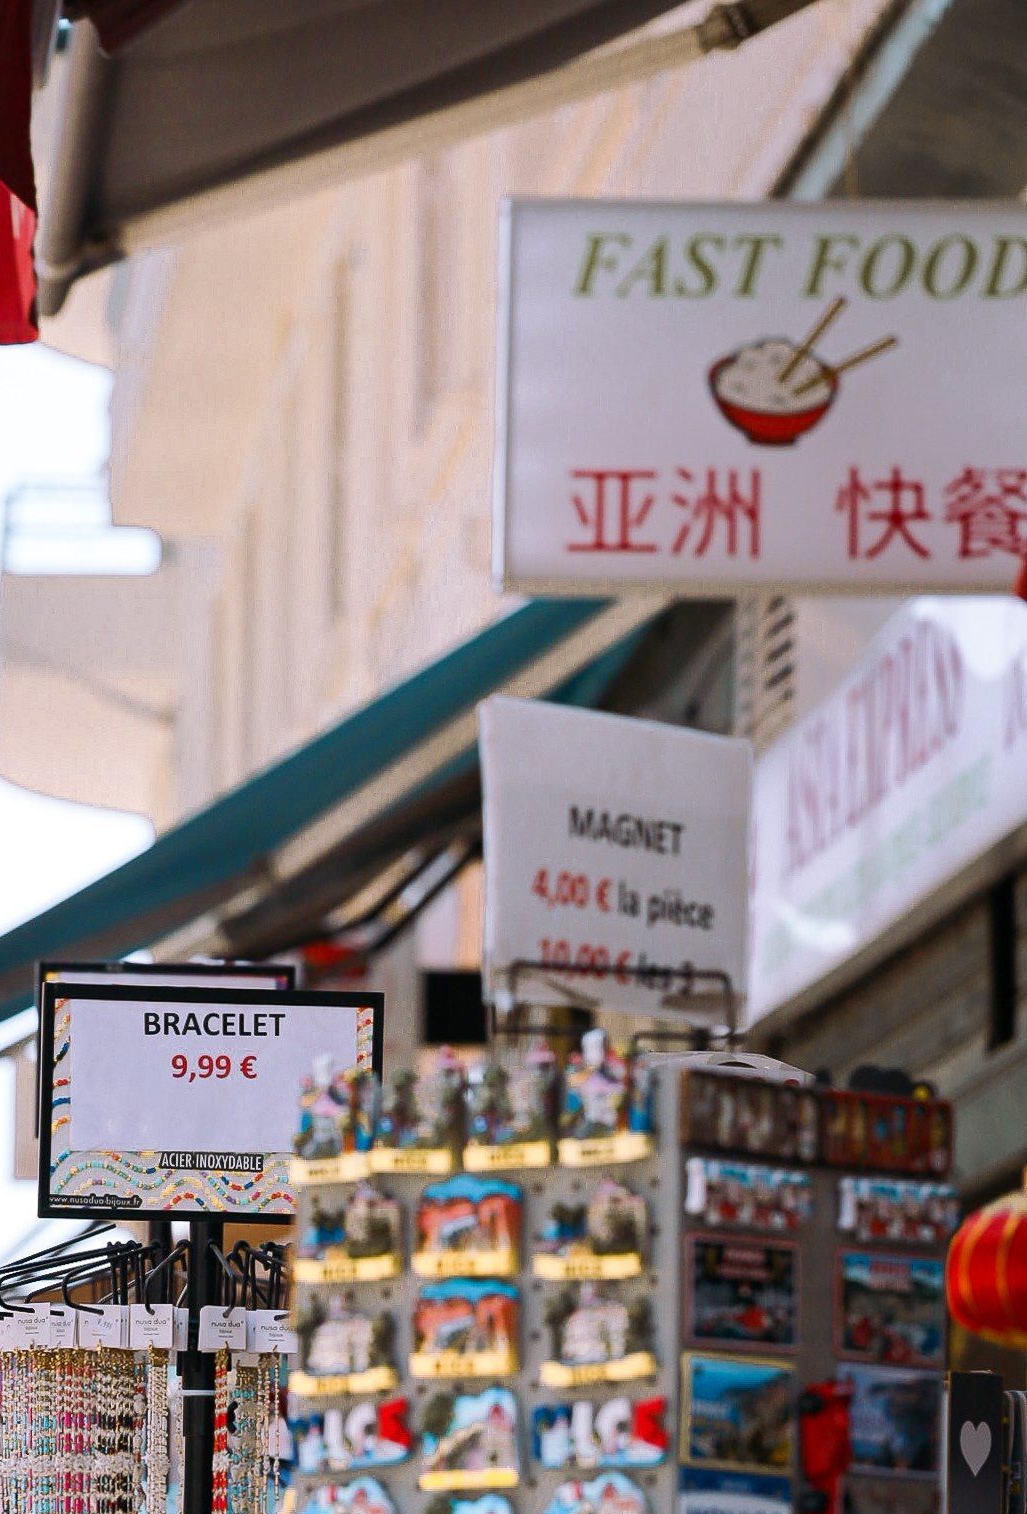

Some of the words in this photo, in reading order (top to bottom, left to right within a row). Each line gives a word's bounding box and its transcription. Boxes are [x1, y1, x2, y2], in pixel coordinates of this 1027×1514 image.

[573, 232, 783, 299] FAST
[567, 467, 762, 559] 亚洲
[569, 805, 685, 855] MAGNET
[531, 867, 590, 909] 4,00
[596, 877, 613, 912] €
[618, 878, 641, 917] la
[647, 887, 715, 931] pièce
[144, 1012, 286, 1037] BRACELET
[171, 1055, 231, 1083] 9,99
[240, 1056, 258, 1079] €
